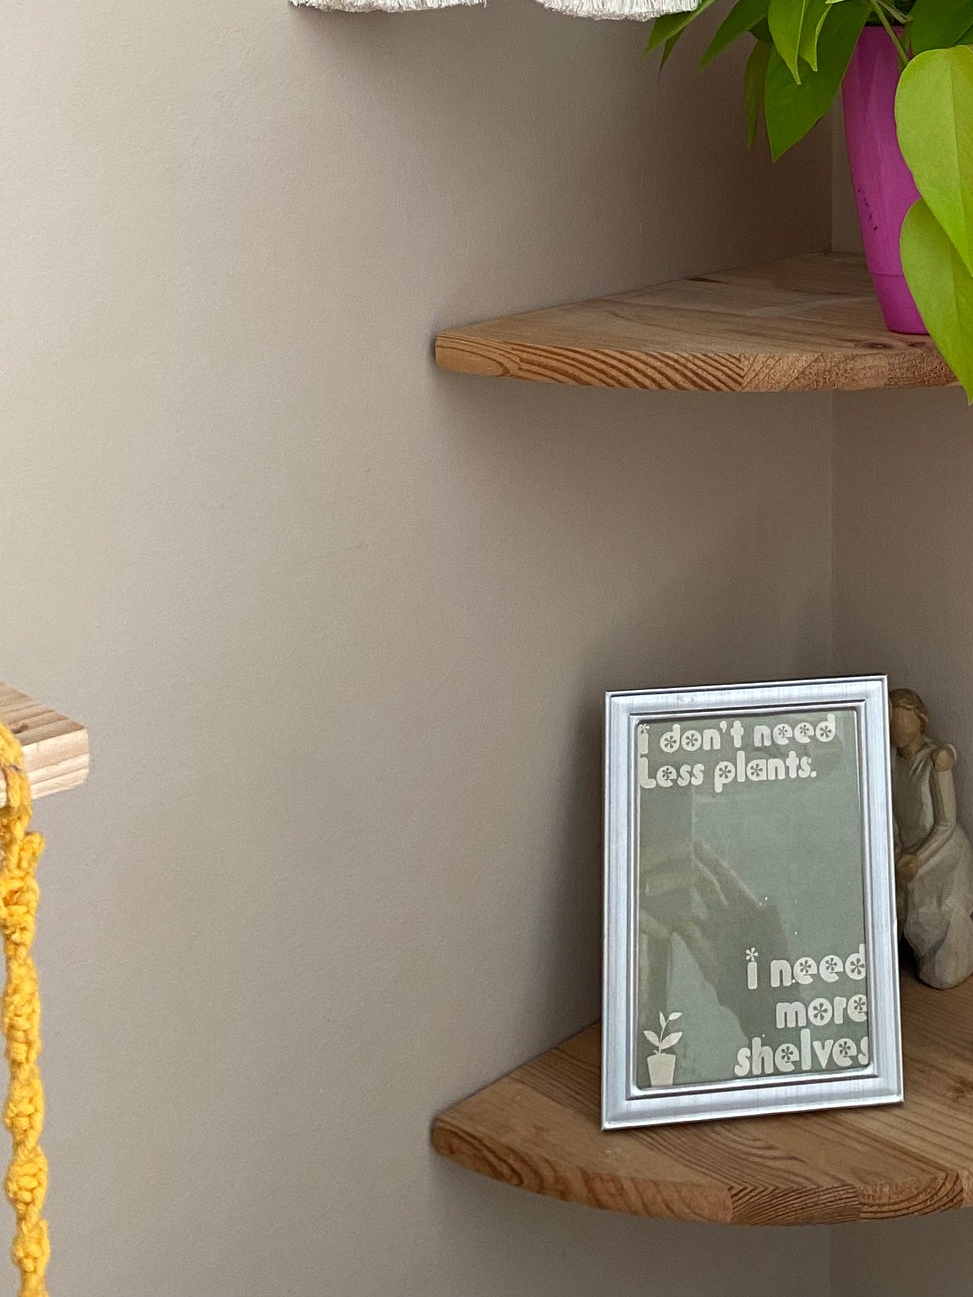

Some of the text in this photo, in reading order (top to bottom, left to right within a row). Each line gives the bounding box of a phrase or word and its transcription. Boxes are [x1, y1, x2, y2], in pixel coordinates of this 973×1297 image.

[638, 713, 836, 754] i don't need
[714, 751, 817, 793] plants.
[745, 943, 867, 990] i need
[776, 994, 868, 1029] more
[734, 1028, 869, 1077] shelves
